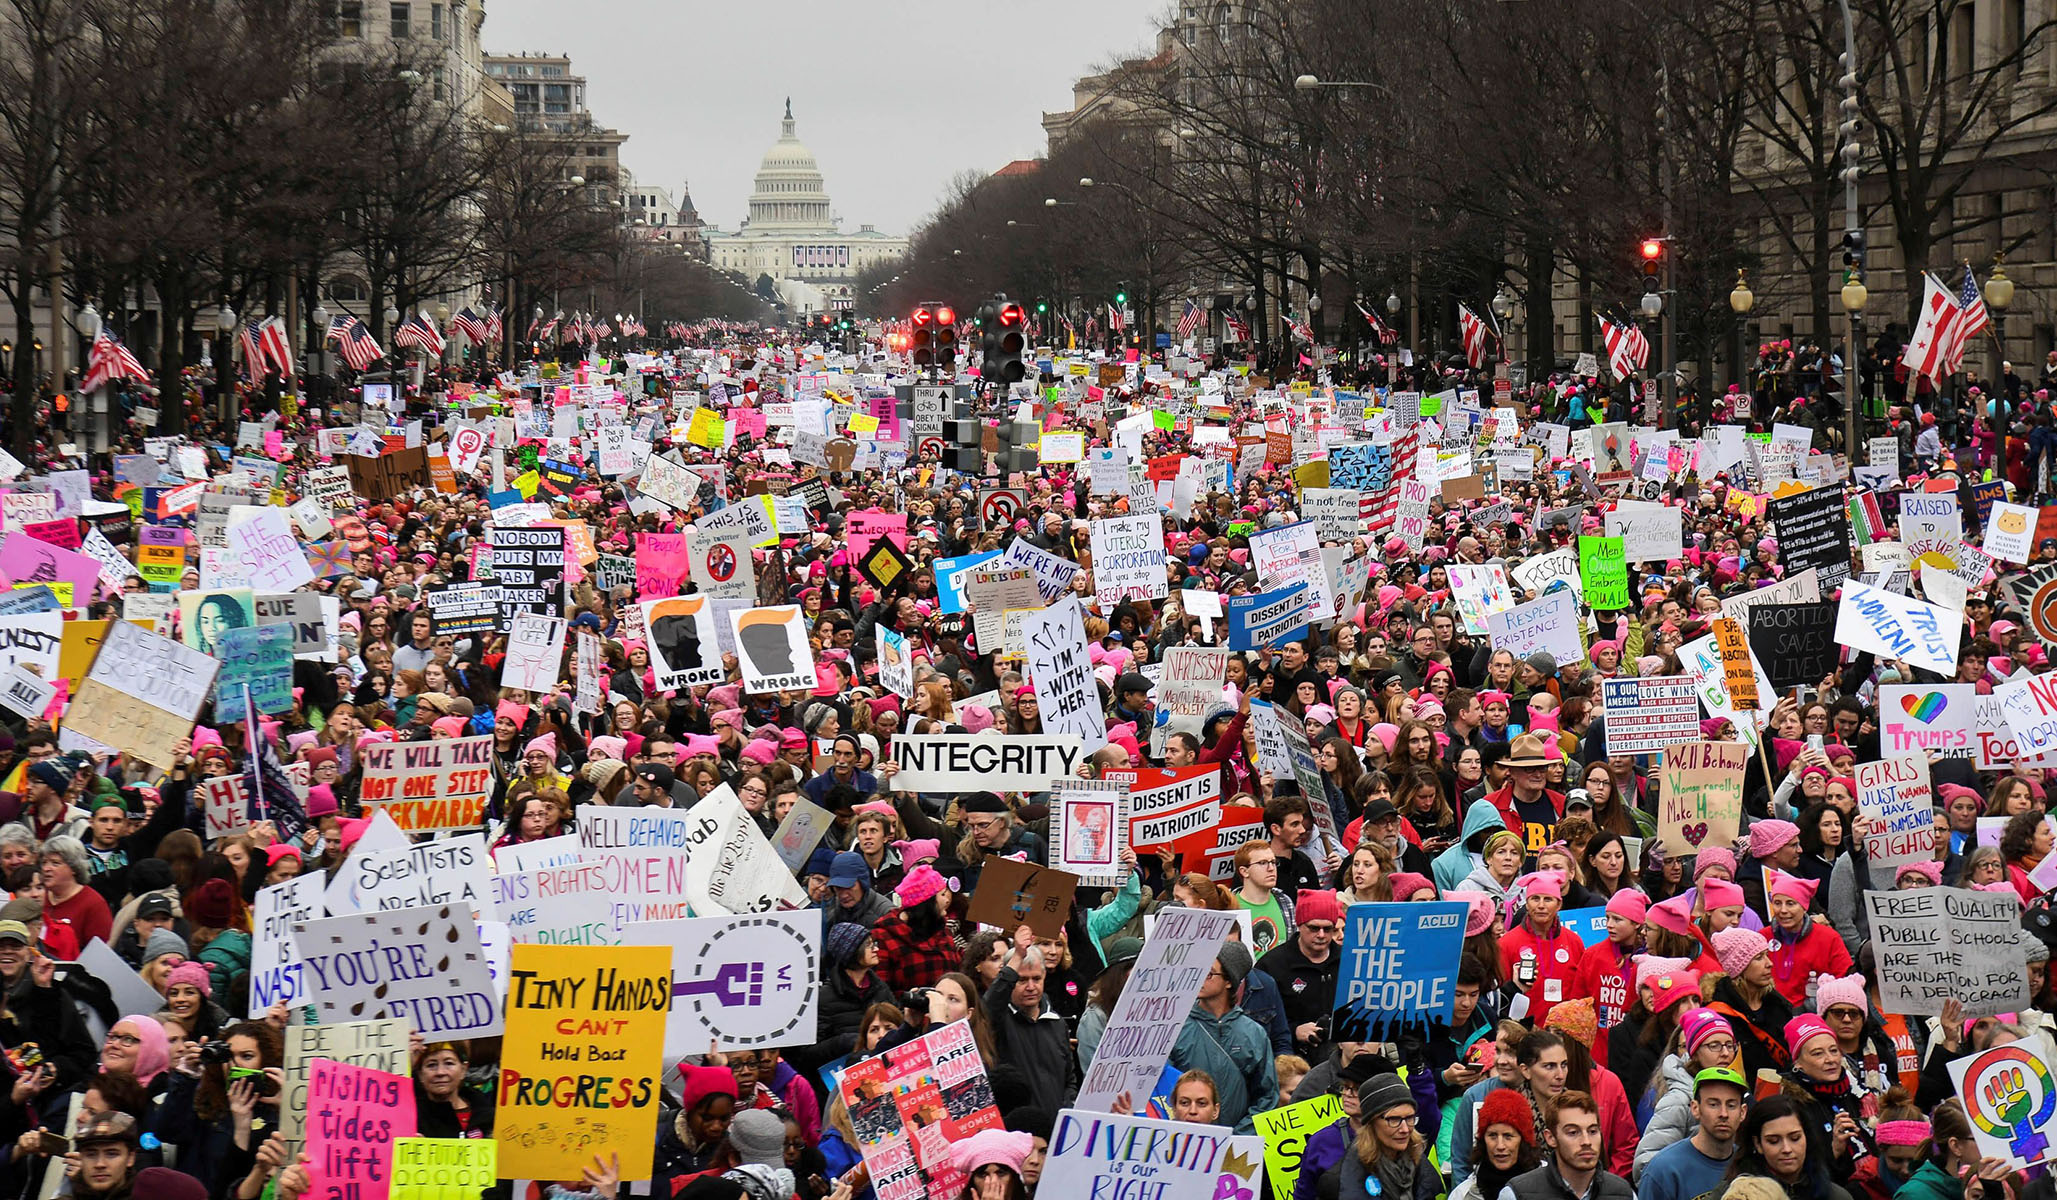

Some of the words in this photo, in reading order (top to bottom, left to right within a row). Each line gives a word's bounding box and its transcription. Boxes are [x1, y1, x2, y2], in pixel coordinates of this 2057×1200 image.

[916, 414, 934, 422] OBEY
[1268, 447, 1288, 455] BACK
[1131, 483, 1150, 496] NOT
[1207, 473, 1224, 486] FEMALE
[4, 494, 49, 507] NASTY
[1131, 496, 1155, 509] THIS
[1316, 495, 1334, 506] not
[1338, 498, 1357, 508] free
[1405, 482, 1426, 501] PRO
[4, 508, 55, 523] WOMEN
[705, 513, 734, 530] THIS
[738, 504, 752, 518] IS
[1400, 501, 1428, 519] WOMEN
[1905, 499, 1952, 516] RAISED
[1111, 521, 1132, 533] make
[1137, 521, 1149, 536] my
[1321, 514, 1334, 525] any
[1402, 518, 1422, 536] PRO
[1921, 522, 1935, 532] TO
[149, 530, 176, 539] SEXISM
[238, 516, 277, 548] HE
[494, 532, 559, 544] NOBODY
[1105, 534, 1147, 551] UTERUS
[1273, 526, 1306, 542] MARCH
[1322, 526, 1355, 537] unfree
[149, 548, 174, 557] RACISM
[240, 534, 296, 576] STARTED
[494, 552, 531, 563] PUTS
[539, 552, 562, 563] MY
[1013, 545, 1049, 574] WE'RE
[1102, 549, 1165, 570] CORPORATION
[1597, 542, 1619, 557] Men
[1908, 539, 1932, 559] RISE
[1935, 539, 1953, 555] UP
[265, 560, 294, 587] IT
[1099, 571, 1112, 583] will
[1115, 572, 1128, 586] you
[1134, 570, 1150, 582] stop
[1525, 556, 1576, 589] RESPECT
[1232, 598, 1253, 606] ACLU
[1251, 598, 1293, 624] DISSENT
[1294, 593, 1303, 606] IS
[1505, 600, 1560, 630] RESPECT
[1753, 606, 1838, 628] ABORTION
[1850, 588, 1916, 658] WOMEN!
[1257, 612, 1303, 642] PATRIOTIC
[1495, 619, 1560, 650] EXISTENCE
[1906, 606, 1953, 665] TRUST
[1522, 640, 1535, 650] OR
[1778, 632, 1825, 654] SAVES
[1052, 655, 1072, 674] I'M
[1166, 651, 1225, 682] NARCISSISM
[1772, 654, 1825, 680] LIVES
[661, 669, 721, 687] WRONG
[750, 675, 813, 690] WRONG
[881, 669, 912, 697] HUMAN
[1048, 668, 1084, 698] WITH
[9, 681, 41, 704] ALLY
[1606, 685, 1616, 696] IN
[1620, 684, 1638, 694] OUR
[1640, 687, 1664, 698] LOVE
[1671, 686, 1696, 696] WINS
[1058, 690, 1086, 717] HER
[1170, 702, 1206, 716] PROBLEM
[1608, 697, 1638, 706] AMERICA
[1609, 717, 1647, 725] DISABILITIES
[1260, 737, 1279, 748] WITH
[1262, 730, 1273, 738] I'M
[368, 748, 394, 769] WE
[406, 745, 442, 768] WILL
[452, 741, 491, 764] TAKE
[1263, 747, 1278, 758] HER
[1609, 741, 1644, 750] DIVERSITY
[1942, 748, 1976, 759] HATE
[894, 741, 1078, 775] INTEGRITY
[1666, 748, 1698, 770] Well
[1107, 772, 1136, 782] ACLU
[1860, 757, 1918, 788] GIRLS
[362, 777, 398, 800] NOT
[404, 774, 436, 797] ONE
[447, 770, 489, 793] STEP
[1134, 783, 1192, 812] DISSENT
[1198, 778, 1210, 795] IS
[1861, 786, 1897, 806] JUST
[1900, 784, 1931, 800] WANNA
[1667, 797, 1692, 824] Make
[1882, 801, 1914, 816] HAVE
[575, 817, 627, 848] WELL
[629, 818, 686, 847] BEHAVED
[1143, 808, 1210, 839] PATRIOTIC
[1868, 830, 1935, 862] RIGHTS
[360, 844, 473, 889] SCIENTISTS
[537, 866, 606, 898] RIGHTS
[272, 883, 299, 912] THE
[1872, 895, 1934, 915] FREE
[1945, 895, 2019, 919] QUALITY
[510, 907, 536, 926] ARE
[1154, 912, 1195, 940] THOU
[1195, 913, 1238, 941] SHALT
[1420, 915, 1457, 927] ACLU
[1356, 917, 1402, 947] WE
[1879, 924, 1941, 943] PUBLIC
[1951, 930, 2020, 946] SCHOOLS
[1158, 942, 1192, 966] NOT
[1352, 948, 1405, 979] THE
[1883, 952, 1919, 966] ARE
[1926, 951, 1963, 966] THE
[305, 940, 434, 991] YOU'RE
[776, 964, 792, 992] WE
[1127, 968, 1165, 993] MESS
[1164, 970, 1201, 992] WITH
[1883, 969, 1980, 987] FOUNDATION
[1986, 973, 2022, 985] FOR
[512, 970, 586, 1009] TINY
[592, 968, 668, 1011] HANDS
[1348, 977, 1448, 1010] PEOPLE
[1900, 985, 1913, 999] A
[1921, 985, 2021, 1004] DEMOCRACY
[389, 992, 494, 1033] FIRED
[1125, 998, 1177, 1022] WOMENS
[302, 1028, 333, 1051] BE
[350, 1023, 393, 1048] THE
[556, 1018, 628, 1035] CAN'T
[541, 1043, 579, 1061] Hold
[1097, 1022, 1181, 1060] REPRODUCTIVE
[936, 1043, 975, 1066] ARE
[938, 1053, 982, 1080] HUMAN
[316, 1066, 399, 1107] rising
[500, 1069, 652, 1108] PROGRESS
[1086, 1062, 1130, 1095] RIGHTS
[901, 1089, 940, 1110] WOMEN
[320, 1104, 390, 1143] tides
[958, 1111, 997, 1134] WOMEN
[1266, 1108, 1304, 1135] WE
[398, 1143, 422, 1165] THE
[1053, 1115, 1228, 1173] DIVERSITY
[326, 1144, 382, 1181] lift
[1109, 1161, 1123, 1173] is
[1132, 1164, 1158, 1176] our
[877, 1166, 918, 1189] ARE
